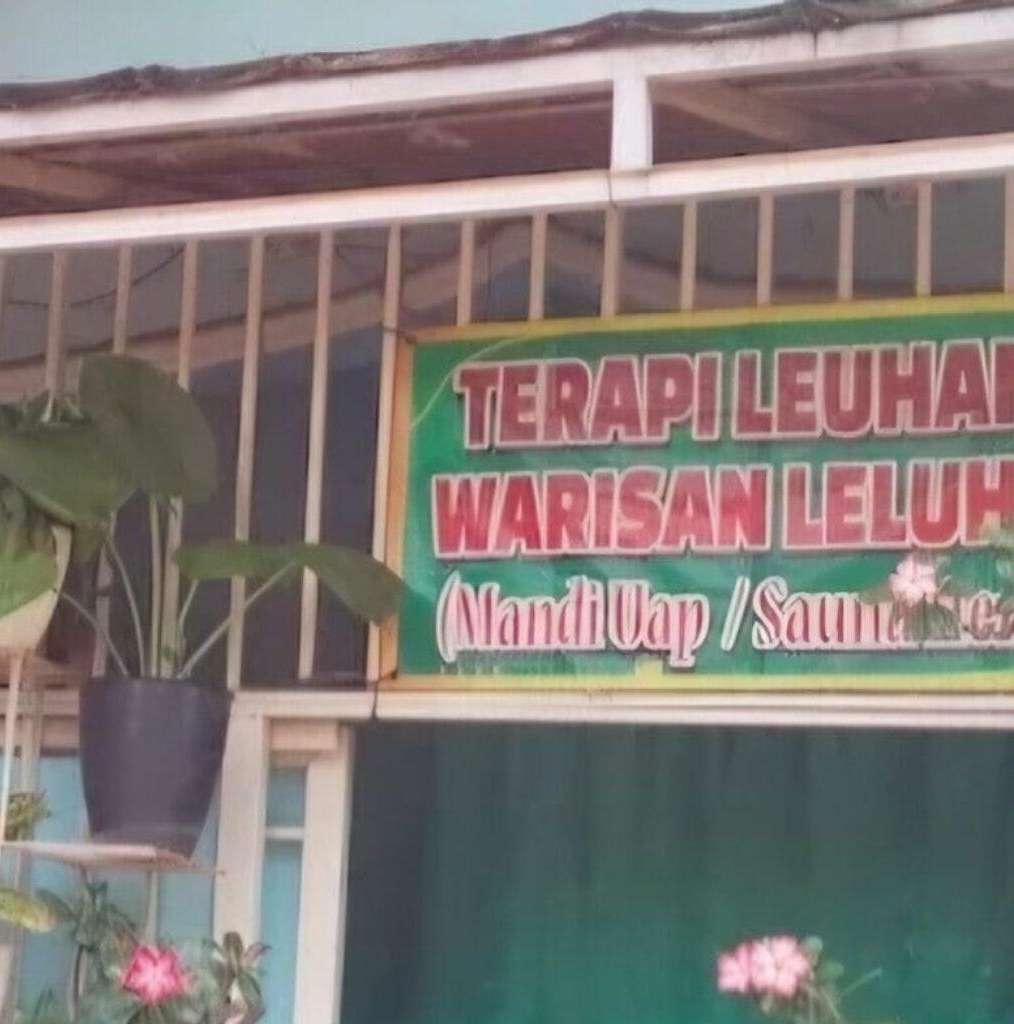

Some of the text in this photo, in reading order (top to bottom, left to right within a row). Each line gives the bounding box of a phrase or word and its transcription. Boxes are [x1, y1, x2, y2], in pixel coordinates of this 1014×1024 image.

[453, 351, 721, 452] TERAPI
[432, 463, 773, 559] WARISAN
[608, 578, 710, 668] Uap
